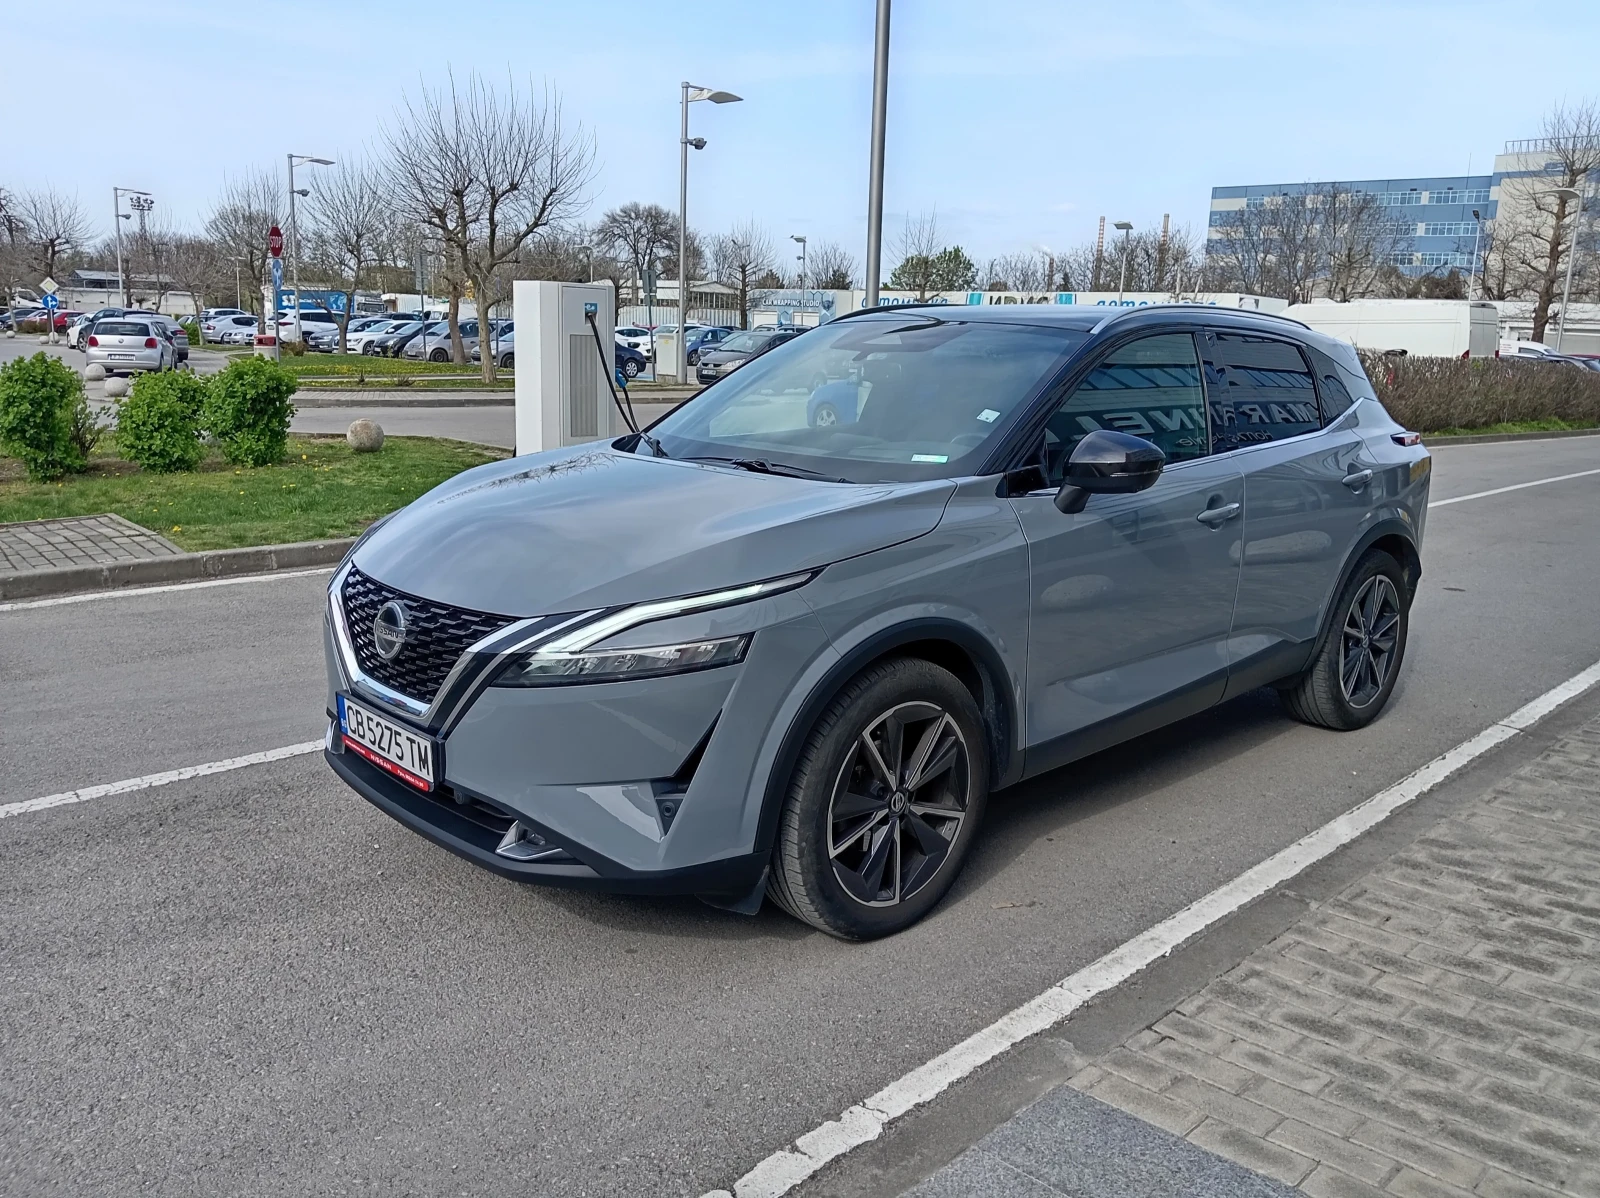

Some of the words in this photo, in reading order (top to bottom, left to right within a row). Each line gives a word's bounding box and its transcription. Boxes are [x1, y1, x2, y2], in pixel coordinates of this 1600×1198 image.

[270, 236, 282, 248] STOP
[773, 299, 800, 307] WRAPPING
[800, 300, 821, 308] STUDIO
[370, 753, 392, 771] NISSAN
